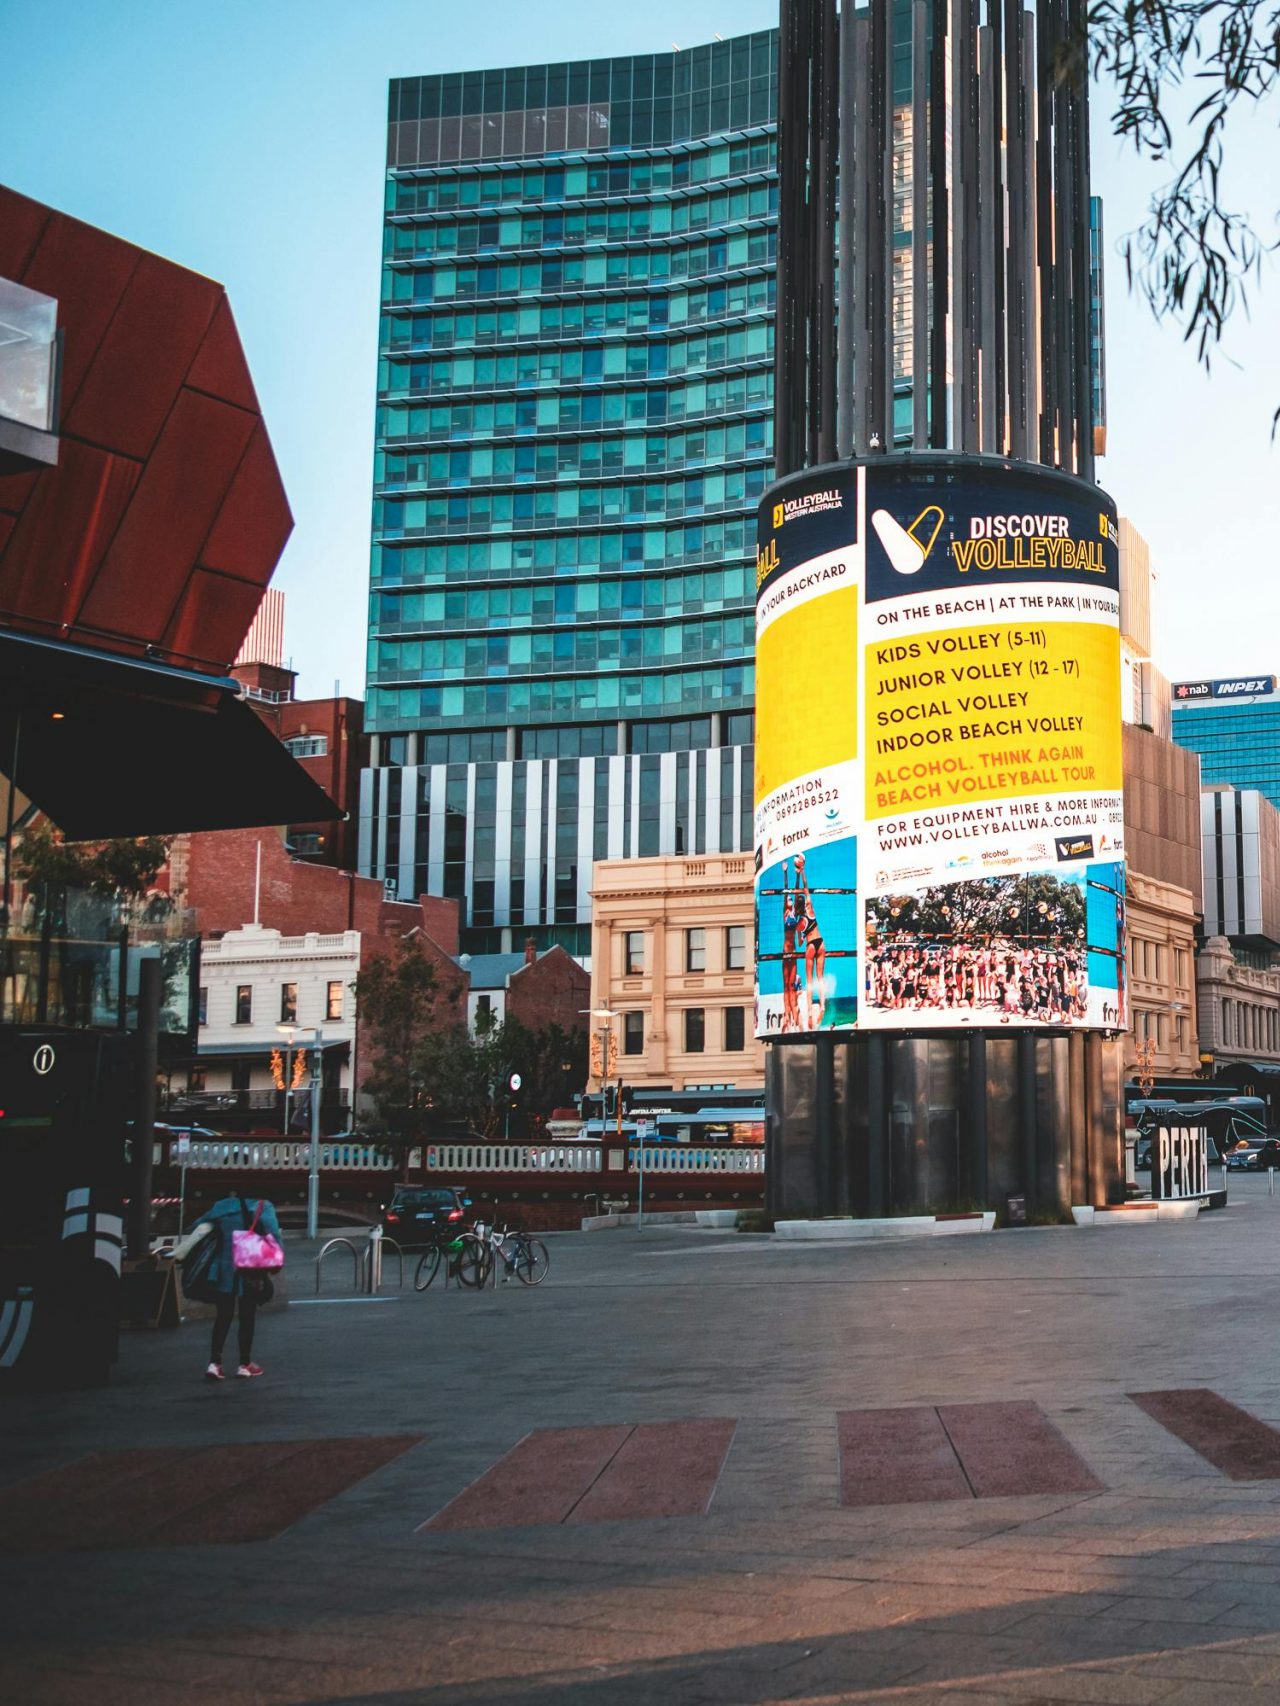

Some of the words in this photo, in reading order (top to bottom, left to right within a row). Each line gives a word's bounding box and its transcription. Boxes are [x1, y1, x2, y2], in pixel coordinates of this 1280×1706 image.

[784, 490, 843, 513] VOLLEYBALL
[784, 511, 808, 522] WESTERN
[808, 501, 843, 513] AUSTRALIA
[970, 515, 1070, 539] DISCOVER
[953, 537, 1107, 574] VOLLEYBALL
[766, 590, 786, 613] YOUR
[787, 563, 847, 597] BACKYARD
[877, 611, 899, 626] ON
[903, 604, 931, 621] THE
[935, 599, 986, 616] BEACH
[999, 597, 1018, 609] AT
[1019, 596, 1045, 609] THE
[1047, 596, 1076, 609] PARK
[1082, 597, 1091, 610] IN
[1092, 599, 1111, 613] YOUR
[877, 643, 922, 665] KIDS
[927, 632, 1001, 655] VOLLEY
[1007, 629, 1047, 650] (5-11)
[876, 670, 946, 696] JUNIOR
[951, 661, 1023, 682] VOLLEY
[1189, 683, 1208, 695] nab
[1217, 680, 1267, 694] INPEX
[877, 700, 952, 727] SOCIAL
[957, 691, 1029, 713] VOLLEY
[876, 727, 954, 755] INDOOR
[959, 719, 1023, 741] BEACH
[1027, 716, 1084, 733] VOLLEY
[874, 757, 975, 787] ALCOHOL.
[979, 748, 1033, 768] THINK
[1037, 745, 1084, 763] AGAIN
[776, 788, 840, 822] 0892288522
[876, 782, 942, 808] BEACH
[947, 770, 1059, 795] VOLLEYBALL
[1061, 766, 1096, 782] TOUR
[877, 821, 907, 837] FOR
[913, 806, 1004, 830] EQUIPMENT
[1010, 802, 1040, 816] HIRE
[1058, 799, 1088, 811] MORE
[879, 814, 1097, 851] WWW.VOLLEYBALLWA.COM.AU
[981, 849, 1009, 859] alcohol
[1159, 1126, 1208, 1199] PERTH
